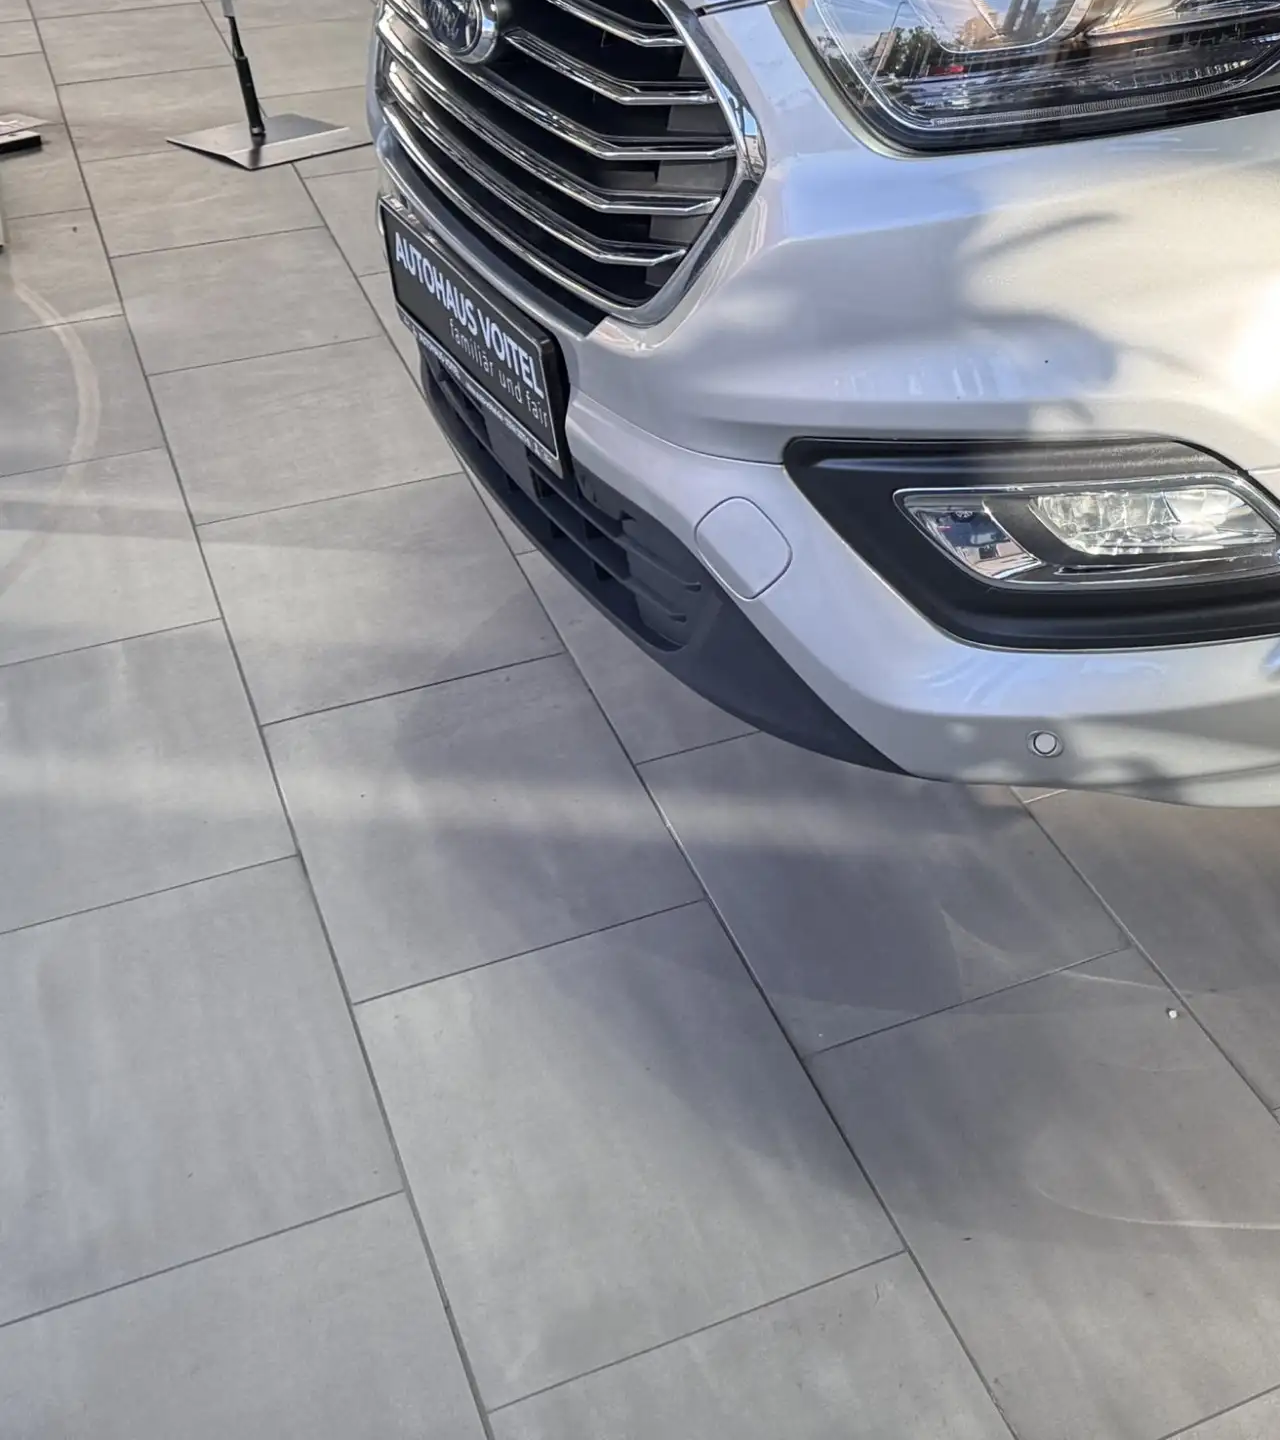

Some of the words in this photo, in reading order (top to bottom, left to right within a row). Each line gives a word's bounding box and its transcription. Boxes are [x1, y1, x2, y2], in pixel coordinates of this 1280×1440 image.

[395, 231, 478, 337] AUTOHAUS
[477, 308, 545, 400] VOITEL
[449, 317, 493, 377] familiär
[499, 369, 523, 404] und
[526, 389, 548, 428] fair
